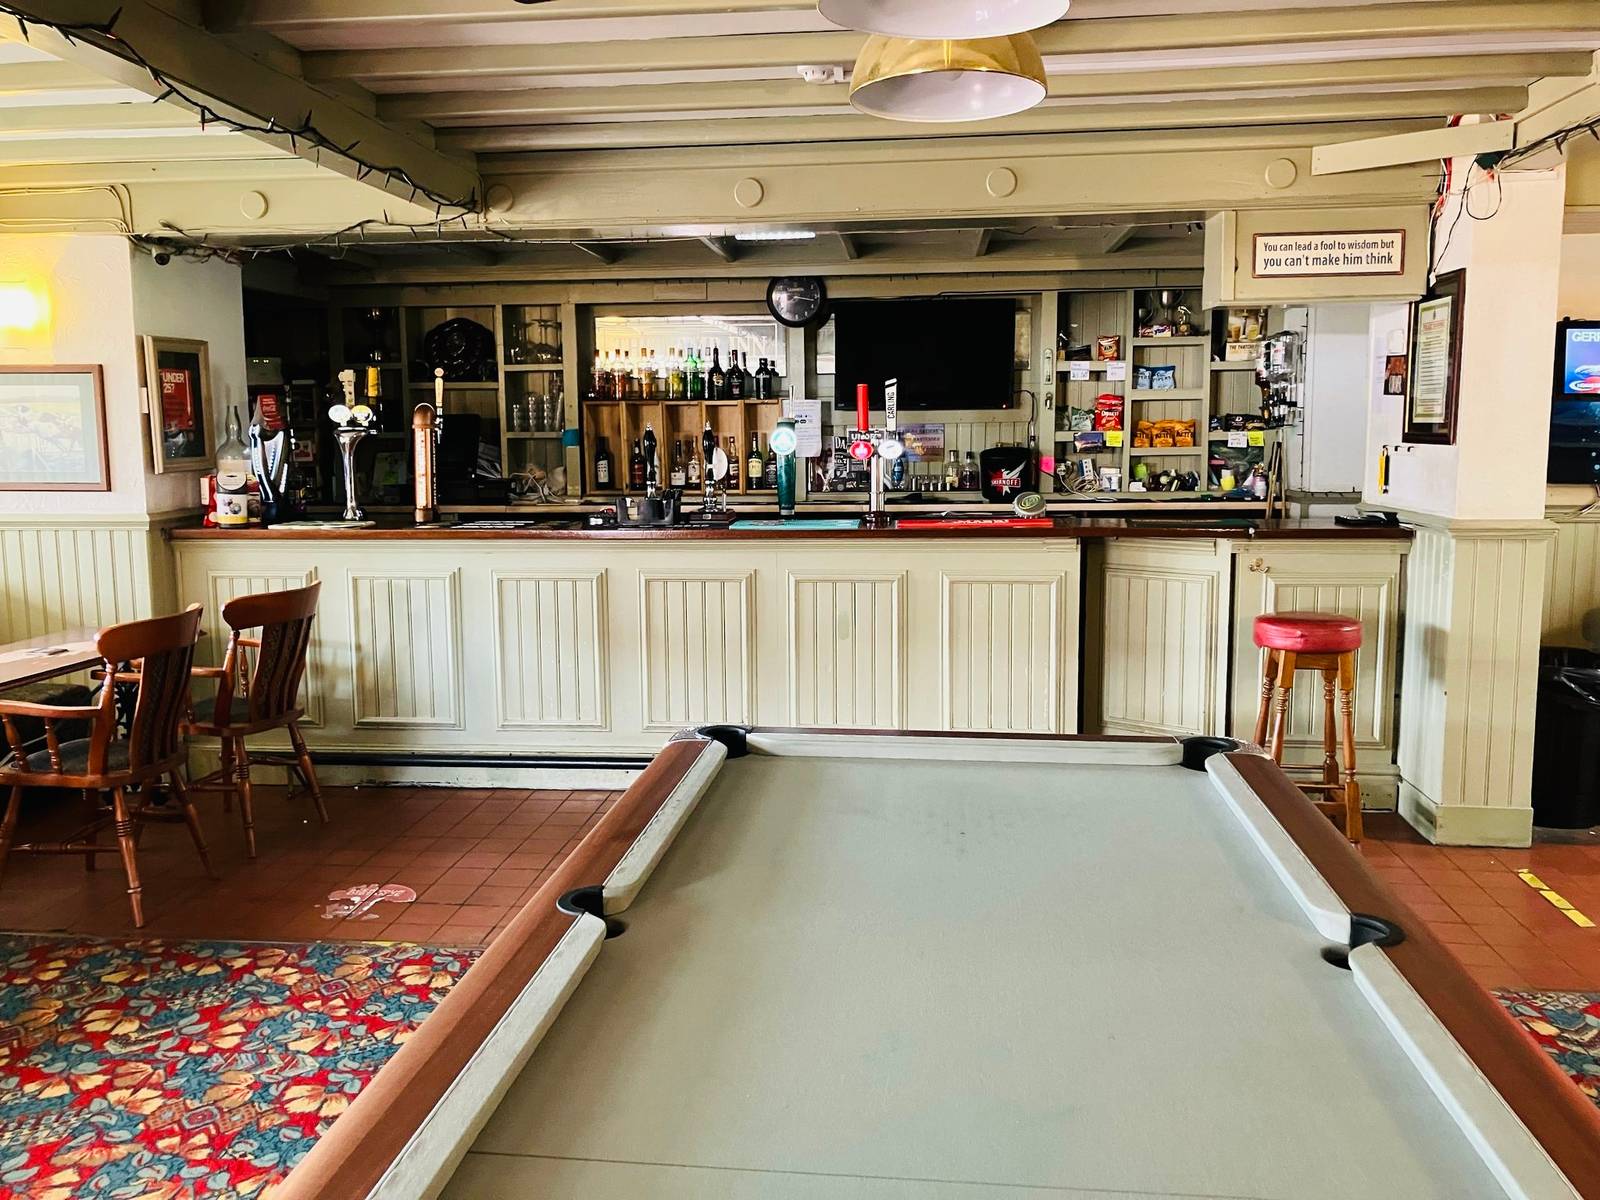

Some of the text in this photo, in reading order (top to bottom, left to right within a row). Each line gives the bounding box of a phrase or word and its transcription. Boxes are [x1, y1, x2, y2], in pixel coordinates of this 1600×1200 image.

[1263, 242, 1278, 252] You
[1279, 244, 1293, 252] can
[1294, 241, 1312, 251] lead
[1320, 240, 1336, 250] fool
[1337, 241, 1346, 250] to
[1347, 240, 1379, 250] wisdom
[1380, 239, 1395, 249] but
[1263, 252, 1393, 270] you can't make him think
[886, 391, 896, 419] CARLING
[835, 436, 848, 449] DA
